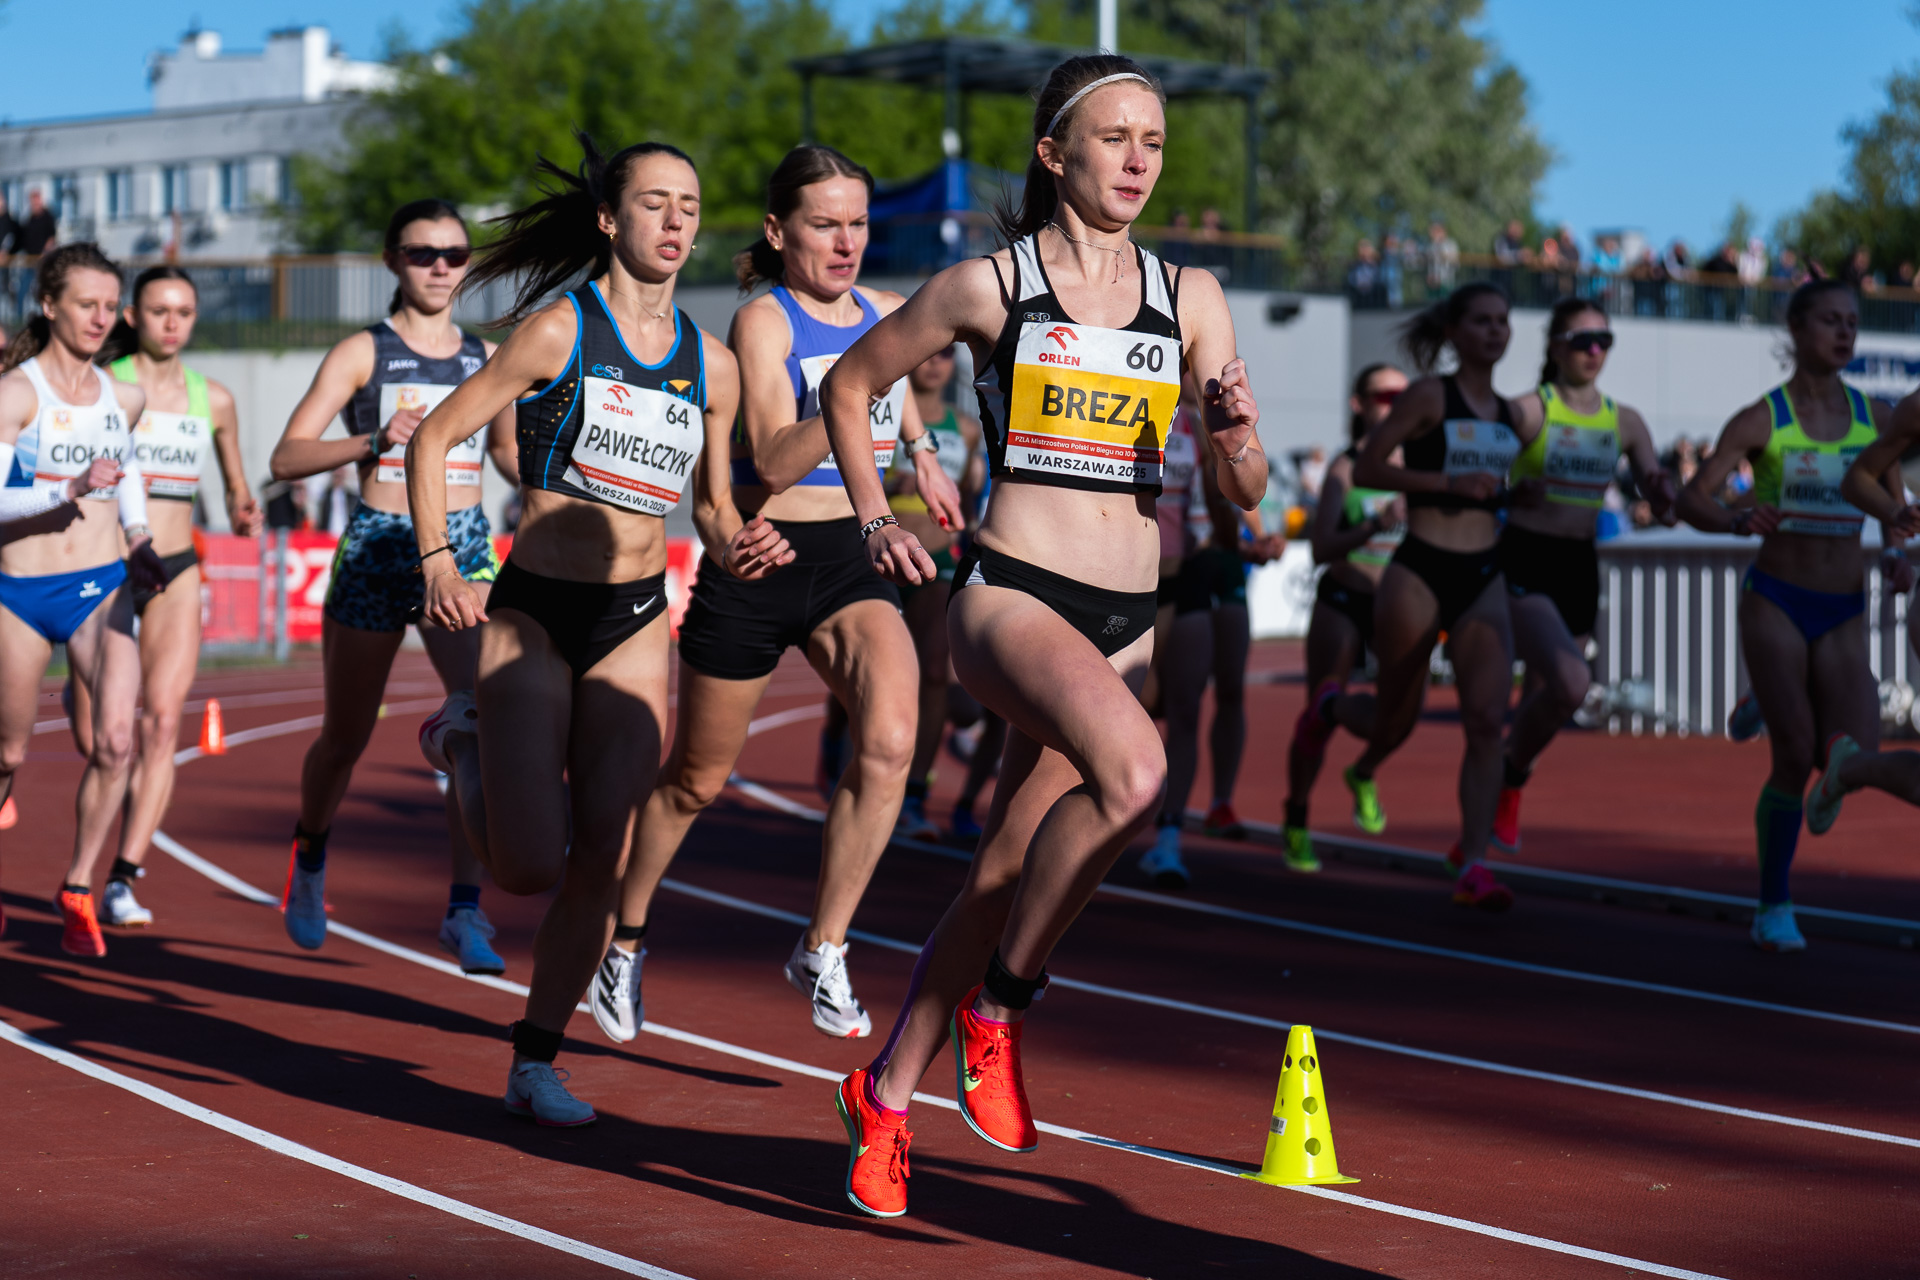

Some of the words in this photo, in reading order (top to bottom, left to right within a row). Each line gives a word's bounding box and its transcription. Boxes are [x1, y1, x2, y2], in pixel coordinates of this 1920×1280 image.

[387, 359, 419, 372] JAKO
[1038, 352, 1081, 367] ORLEN
[1126, 342, 1164, 373] 60
[602, 402, 633, 417] ORLEN
[665, 403, 689, 430] 64
[1041, 383, 1149, 430] BREZA
[178, 420, 197, 436] 42
[51, 443, 124, 464] CIOŁAK
[135, 443, 197, 464] CYGAN
[583, 424, 693, 477] PAWEŁCZYK
[1015, 435, 1030, 444] PZLA
[1031, 438, 1070, 449] Mistrzostwa
[1071, 443, 1089, 452] Polski
[1096, 446, 1114, 456] Biegu
[875, 454, 891, 463] 025
[1027, 453, 1115, 475] WARSZAWA
[1118, 465, 1147, 479] 2025
[582, 478, 648, 508] WARSZAWA
[648, 500, 667, 512] 2025
